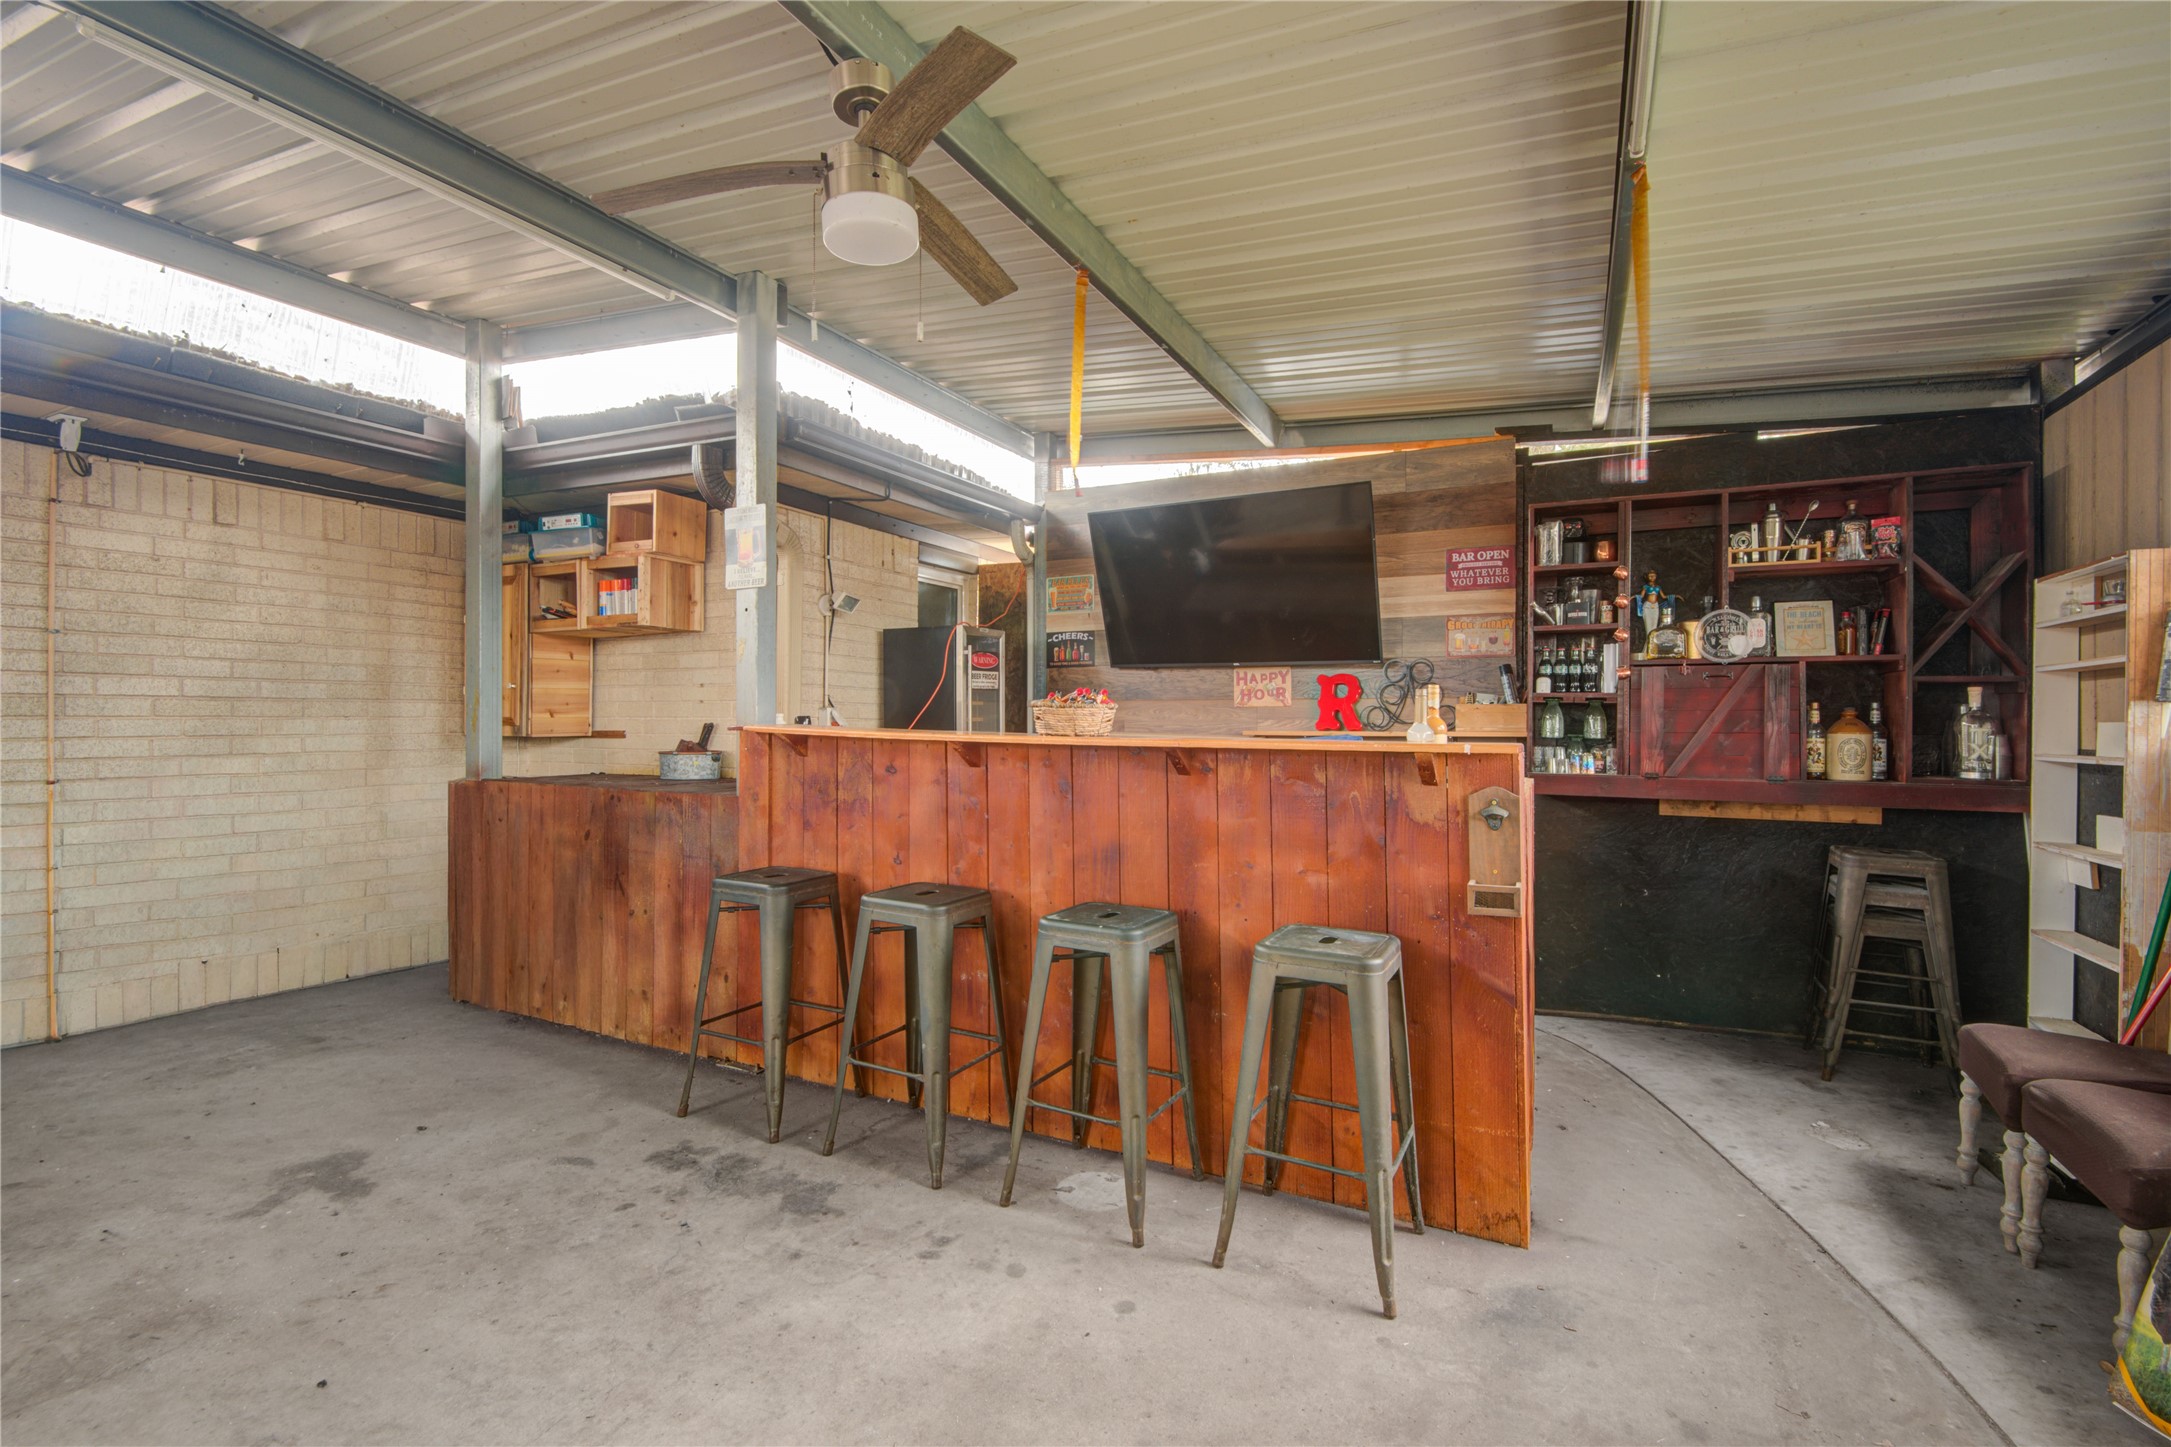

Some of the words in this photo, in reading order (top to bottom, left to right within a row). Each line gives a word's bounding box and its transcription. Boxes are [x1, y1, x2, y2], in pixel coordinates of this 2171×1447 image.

[1452, 552, 1475, 562] BAR
[1477, 549, 1510, 560] OPEN
[1450, 567, 1509, 578] WHATEVER
[1452, 577, 1474, 586] YOU
[1477, 575, 1510, 585] BRING
[1706, 624, 1719, 634] BAR
[1052, 632, 1089, 642] CHEERS
[982, 673, 998, 681] FRIDGE
[1235, 669, 1289, 687] HAPPY
[1241, 687, 1287, 703] HOUR
[1315, 673, 1363, 731] R
